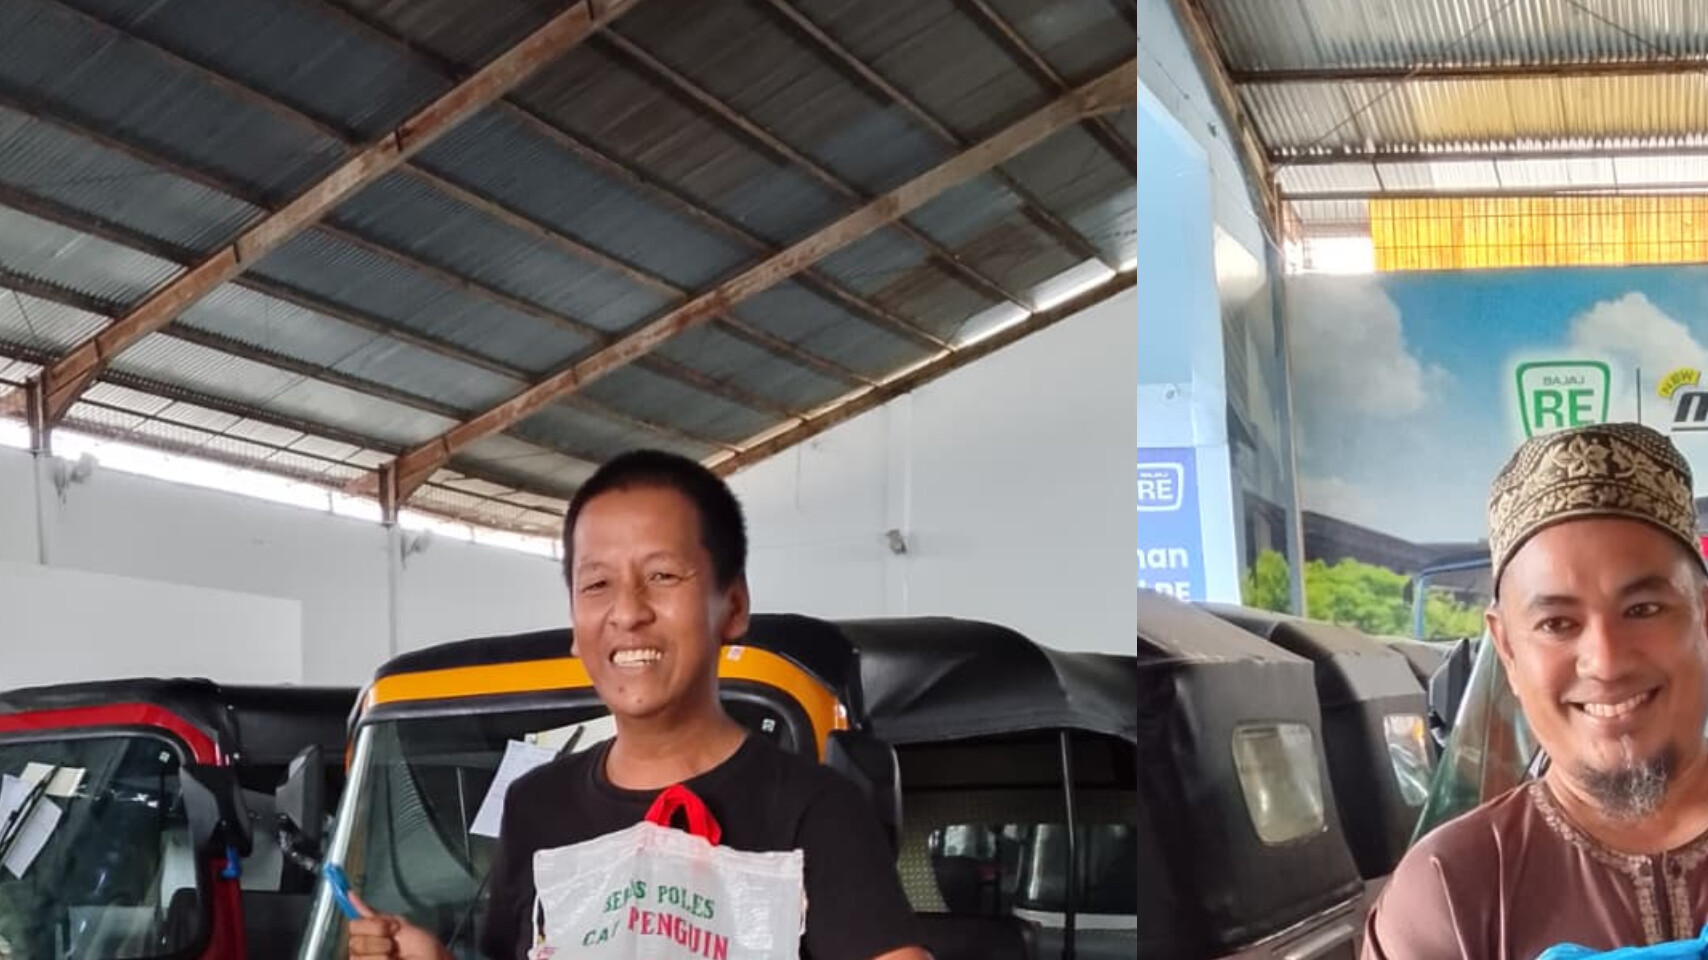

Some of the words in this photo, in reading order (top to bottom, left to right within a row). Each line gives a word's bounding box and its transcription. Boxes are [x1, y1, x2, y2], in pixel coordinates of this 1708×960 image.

[1542, 374, 1586, 386] BAJAJ
[1660, 368, 1693, 396] NEW
[1532, 388, 1595, 428] RE
[1137, 478, 1174, 501] RE
[657, 884, 716, 920] POLES
